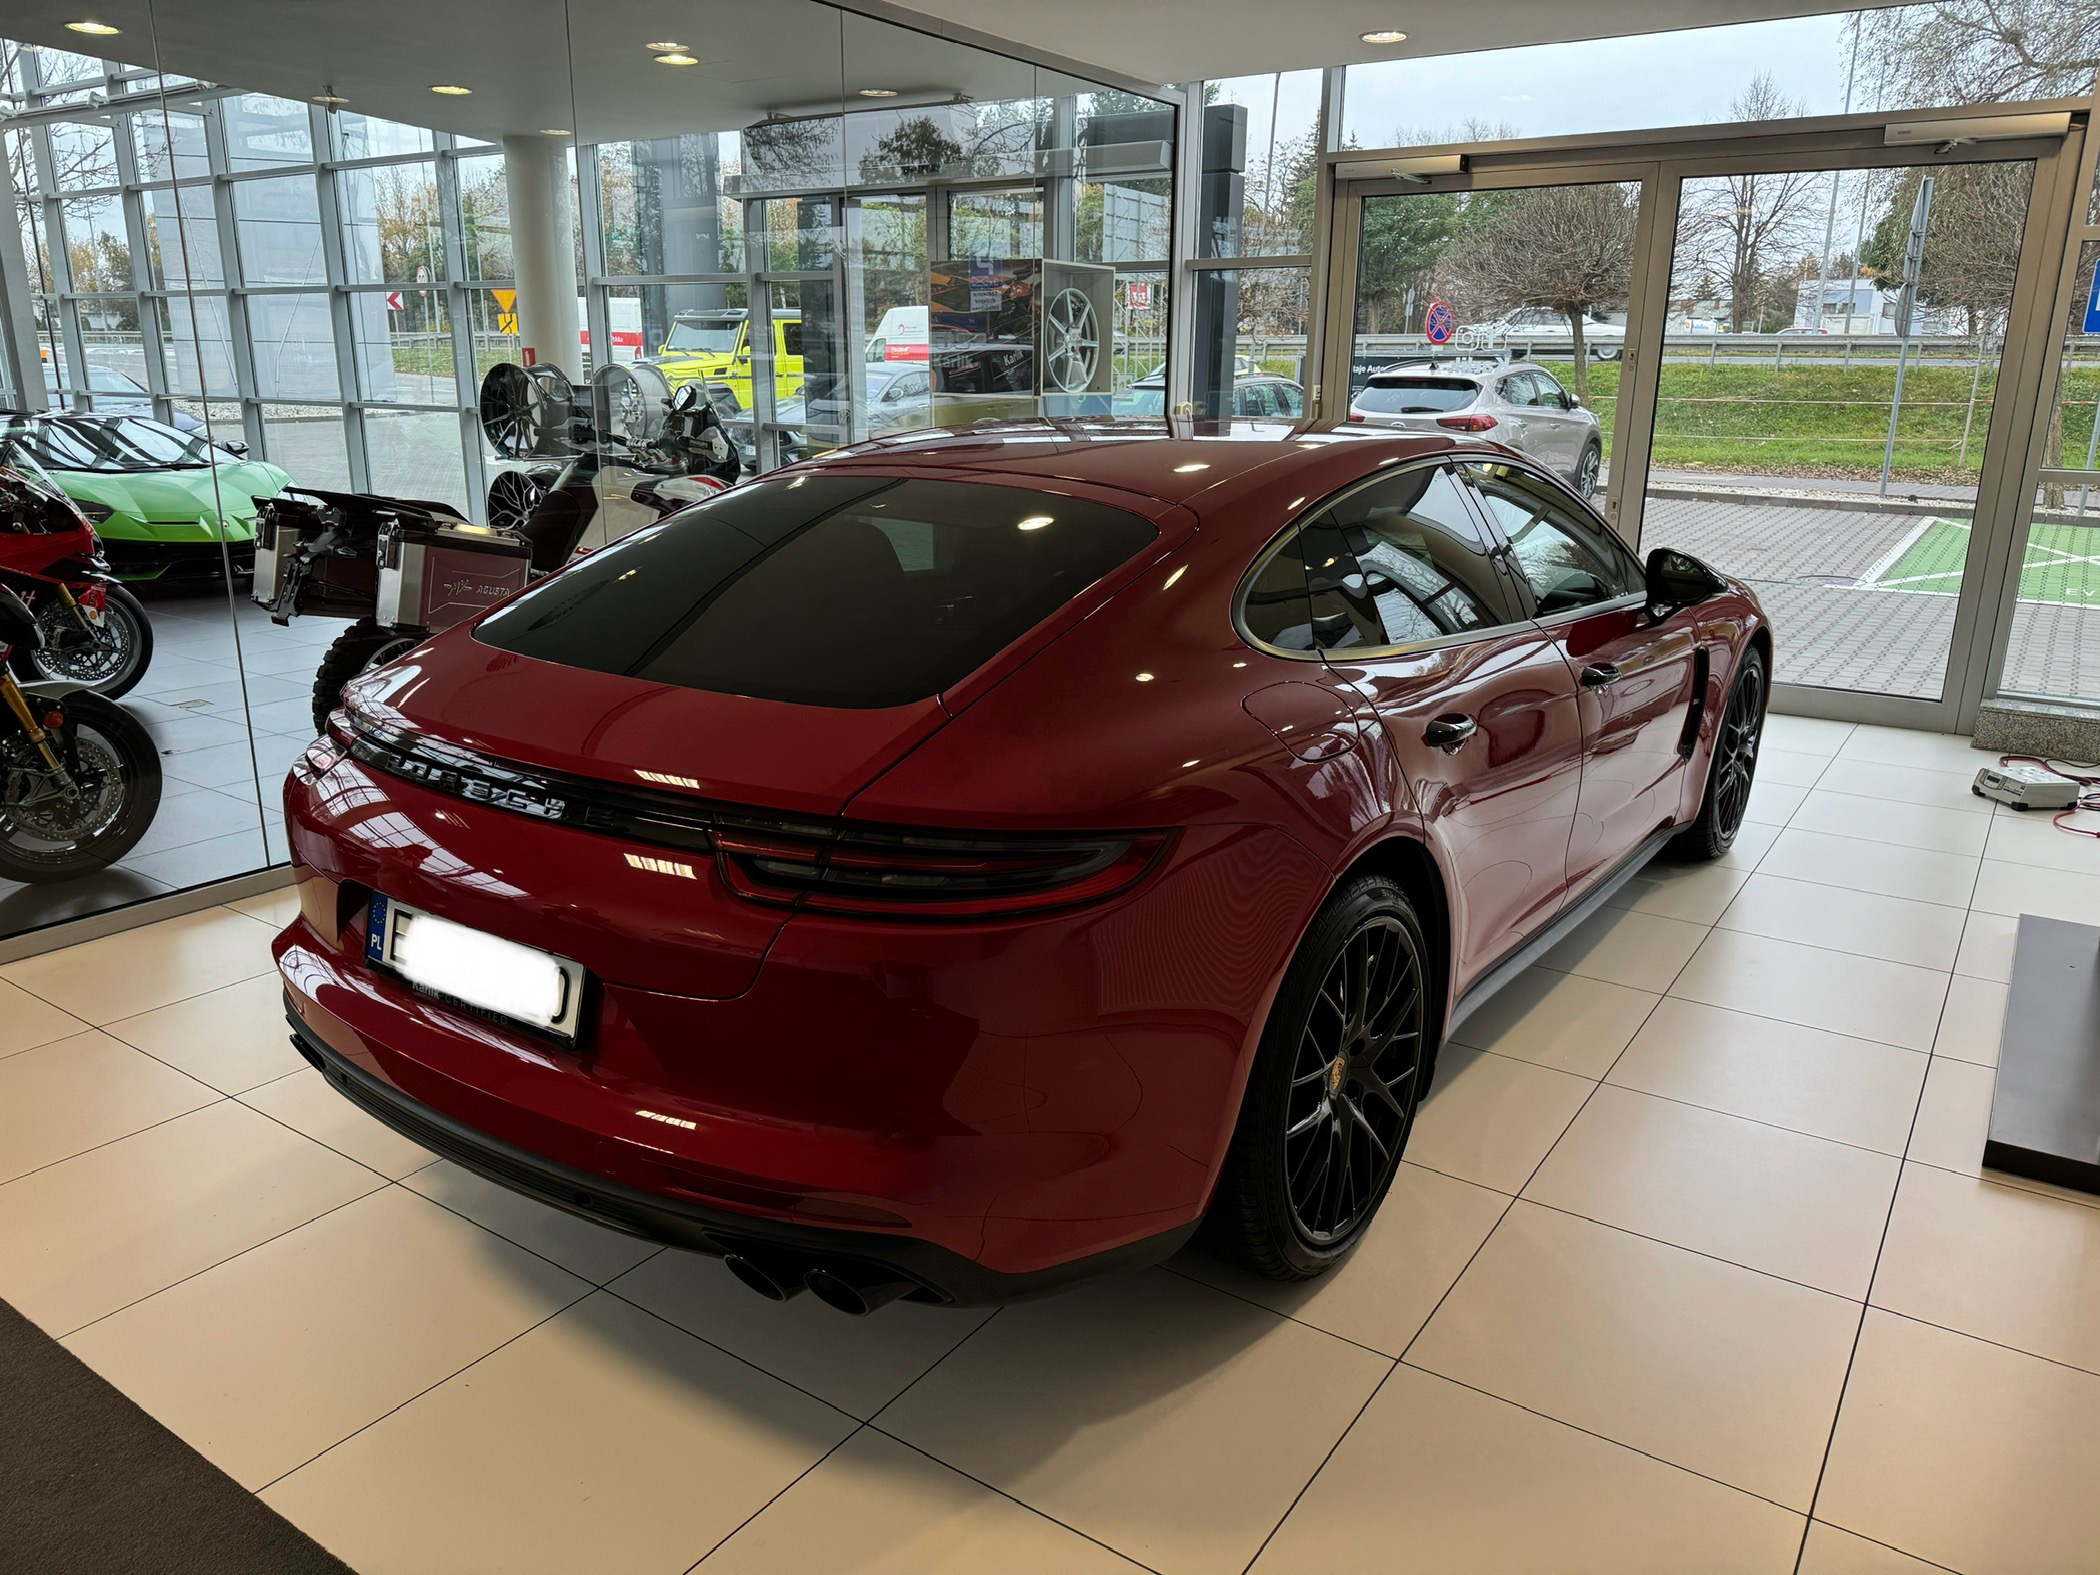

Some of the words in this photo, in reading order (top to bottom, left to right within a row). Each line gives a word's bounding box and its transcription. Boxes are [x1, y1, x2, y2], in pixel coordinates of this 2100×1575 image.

[475, 585, 510, 597] AGUSTA
[385, 751, 617, 827] PORSCHE
[370, 933, 382, 951] PL
[444, 994, 508, 1025] CERTIFIED
